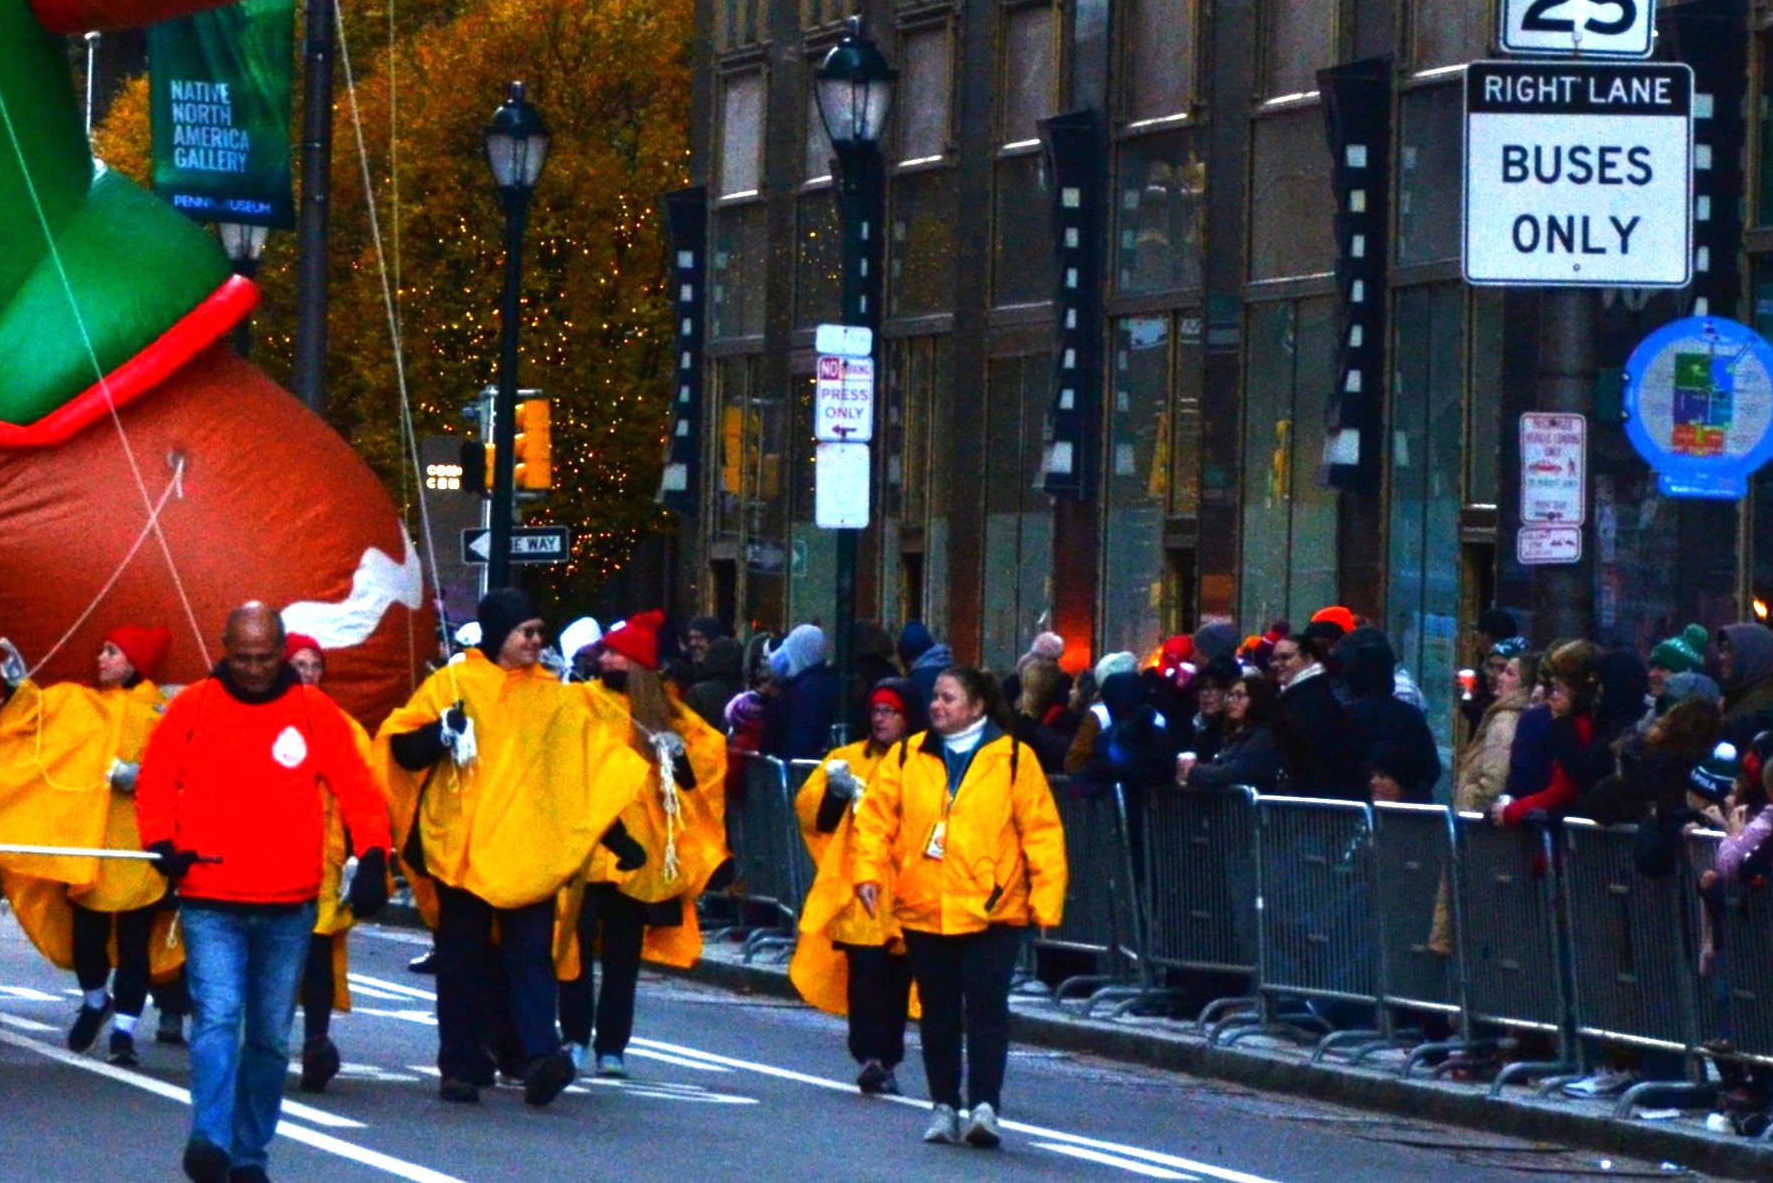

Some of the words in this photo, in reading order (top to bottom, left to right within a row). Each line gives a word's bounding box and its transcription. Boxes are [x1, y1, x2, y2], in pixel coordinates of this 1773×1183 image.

[170, 79, 230, 102] NATIVE
[1484, 75, 1576, 103] RIGHT
[1589, 77, 1672, 104] LANE
[172, 103, 231, 126] NORTH
[173, 125, 249, 149] AMERICA
[174, 148, 246, 172] GALLERY
[1501, 144, 1653, 187] BUSES
[1511, 213, 1641, 255] ONLY
[821, 359, 838, 378] NO
[821, 387, 869, 401] PRESS
[824, 406, 865, 419] ONLY
[527, 536, 557, 551] WAY
